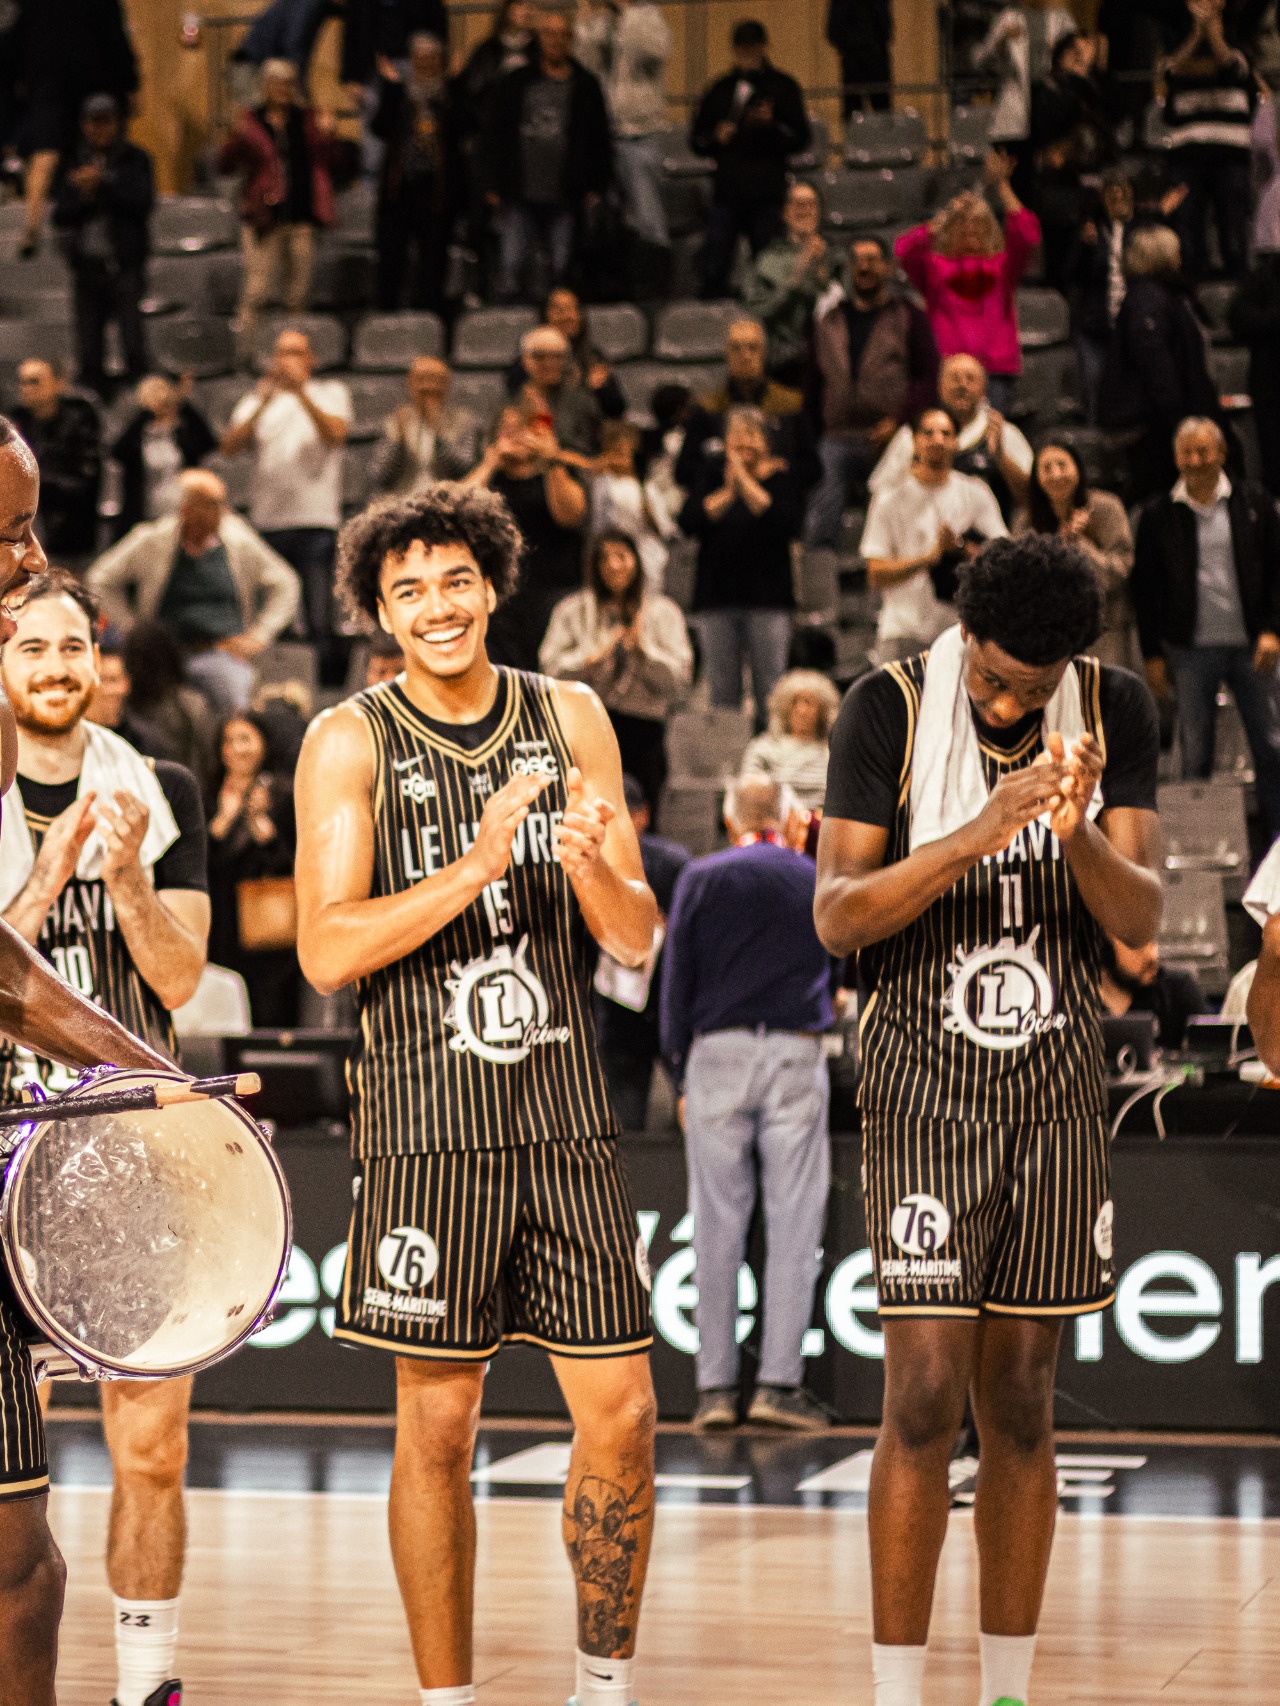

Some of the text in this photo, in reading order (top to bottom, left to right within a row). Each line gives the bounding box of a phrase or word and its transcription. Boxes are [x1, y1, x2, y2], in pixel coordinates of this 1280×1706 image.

[402, 810, 564, 879] LE HVRE
[482, 879, 514, 938] 15
[999, 873, 1023, 929] 11
[899, 1202, 937, 1254] 76
[388, 1233, 426, 1290] 76
[120, 1611, 151, 1628] 23
